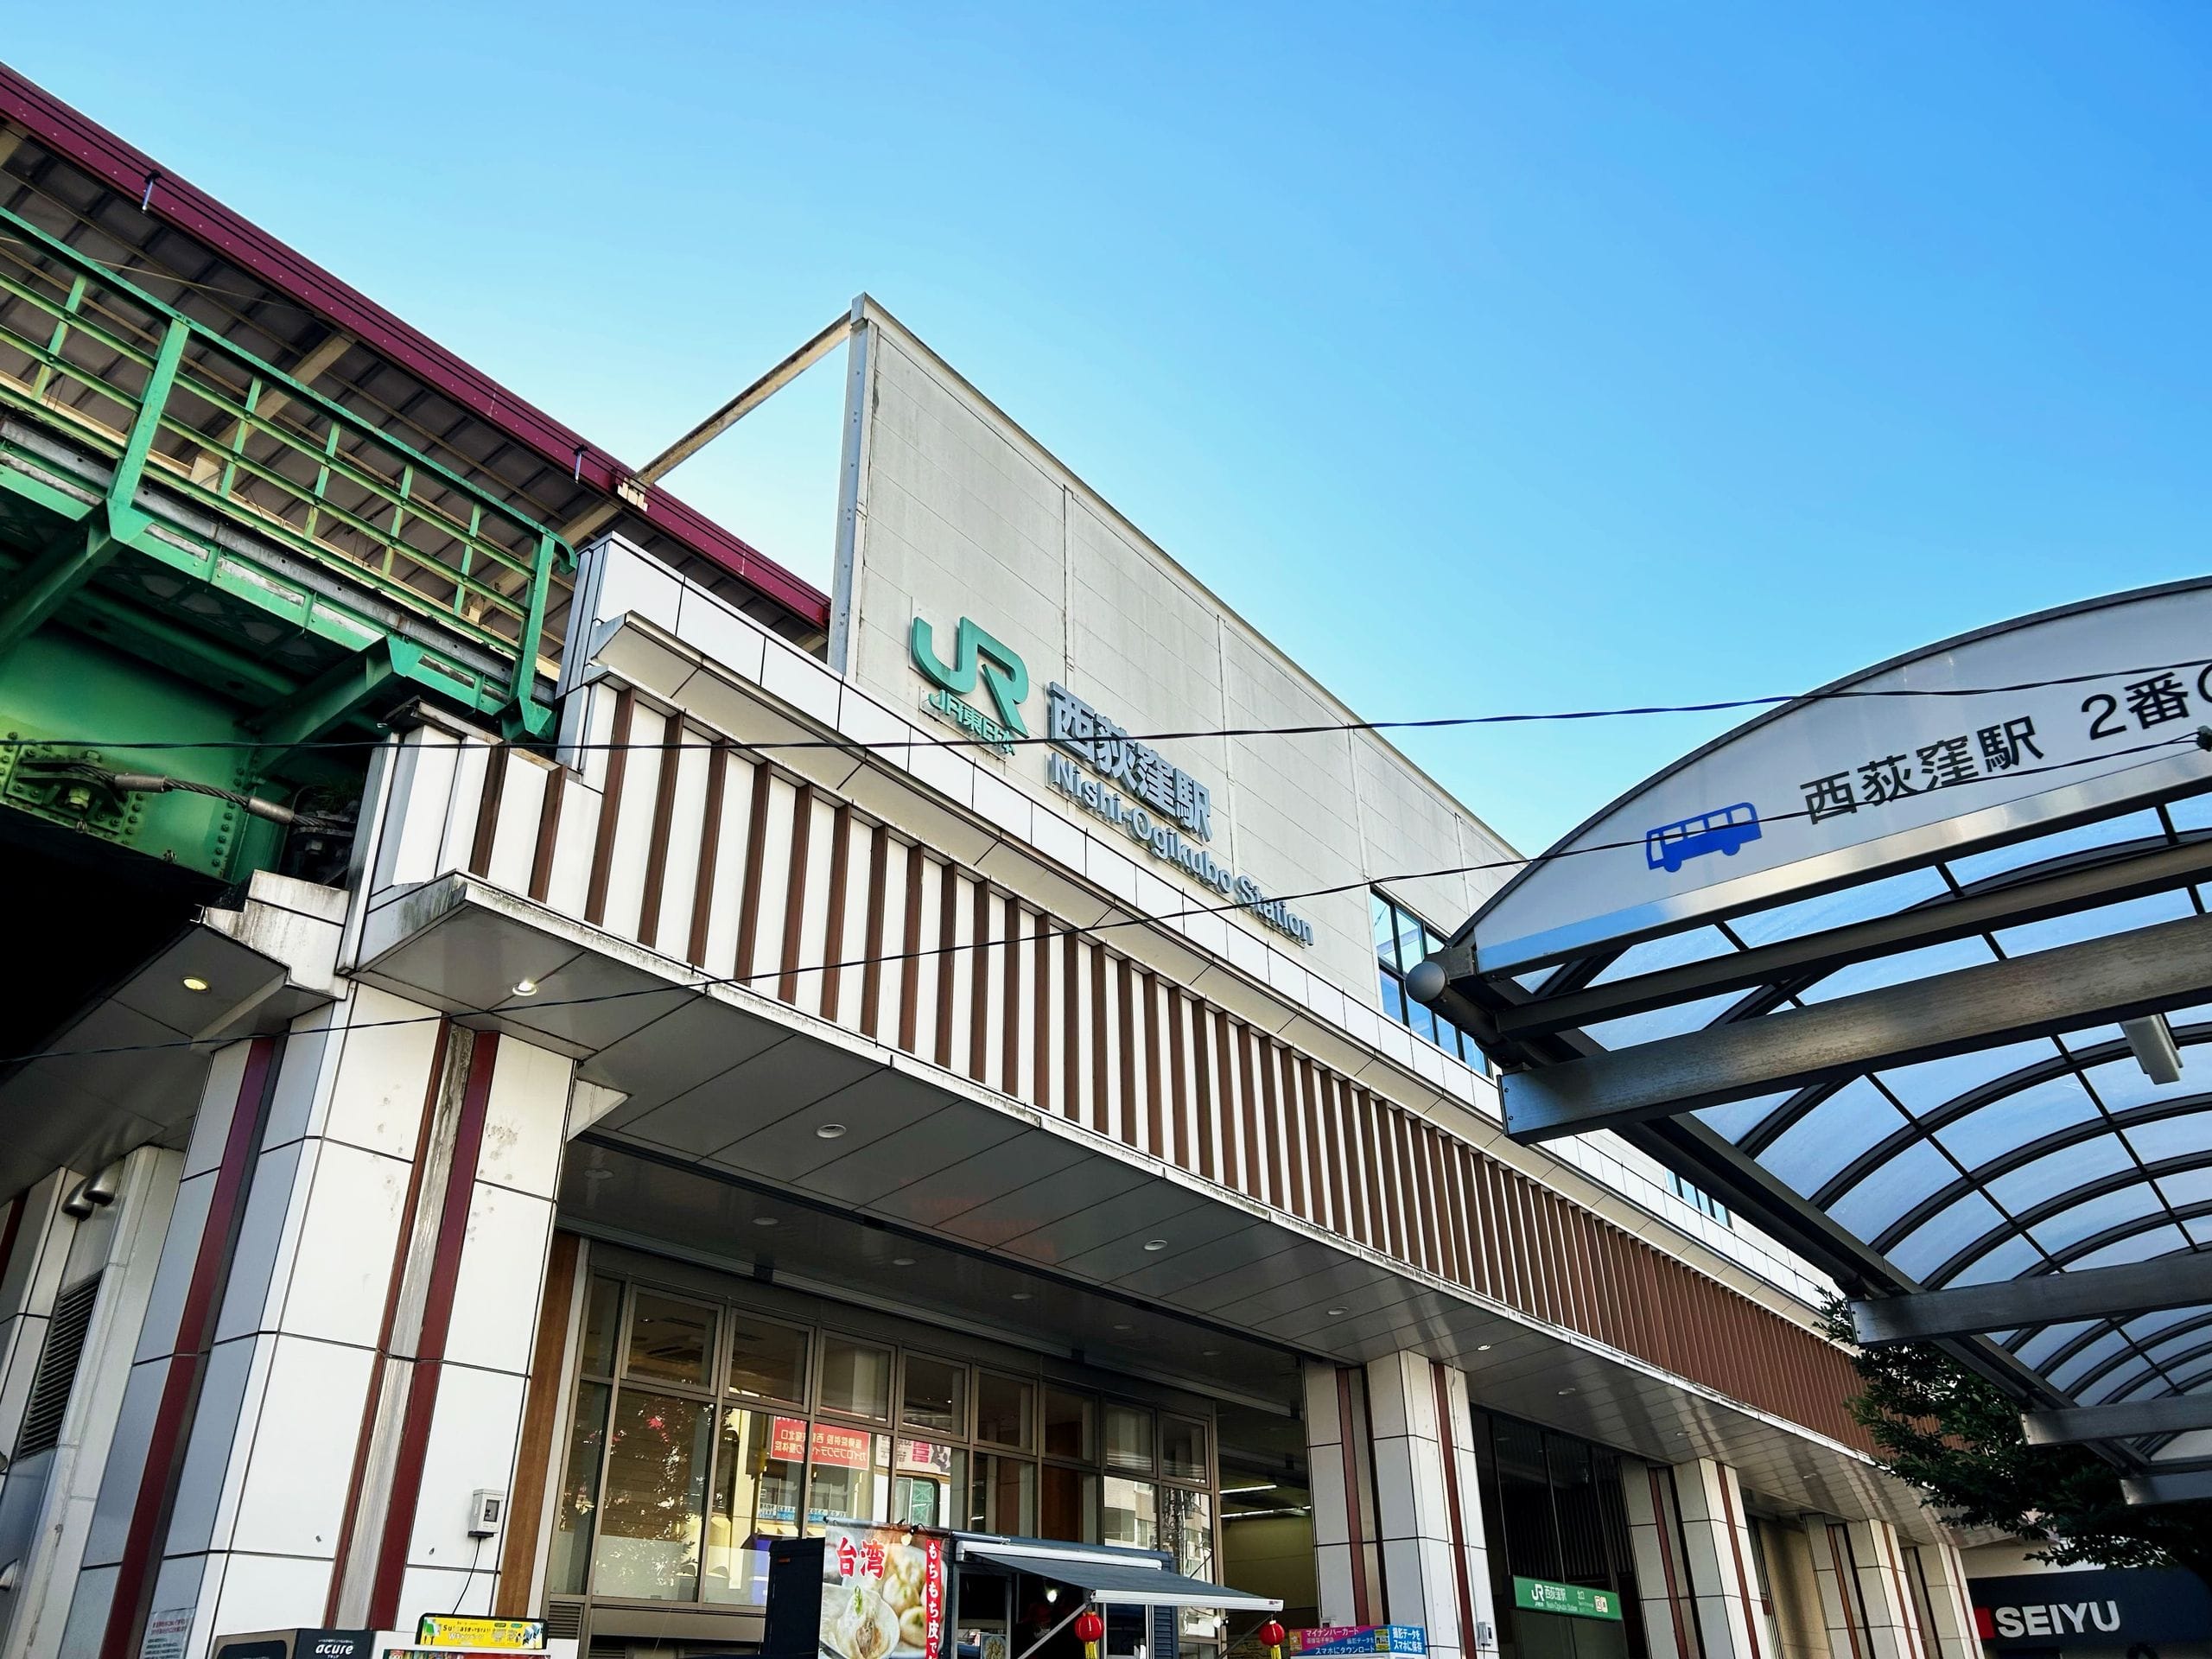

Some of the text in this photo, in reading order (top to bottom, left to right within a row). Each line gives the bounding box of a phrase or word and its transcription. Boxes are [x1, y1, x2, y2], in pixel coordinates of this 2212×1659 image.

[912, 615, 1029, 739] JR
[1047, 682, 1212, 842] 西荻窪駅
[1800, 715, 2044, 824] 西荻窪駅
[1047, 753, 1314, 947] Nishi-Ogikubo Station
[836, 1536, 886, 1580] 台湾
[927, 1541, 940, 1659] もちもち皮で
[1531, 1584, 1545, 1602] JR
[315, 1643, 354, 1655] acure
[1996, 1600, 2120, 1637] SEIYU
